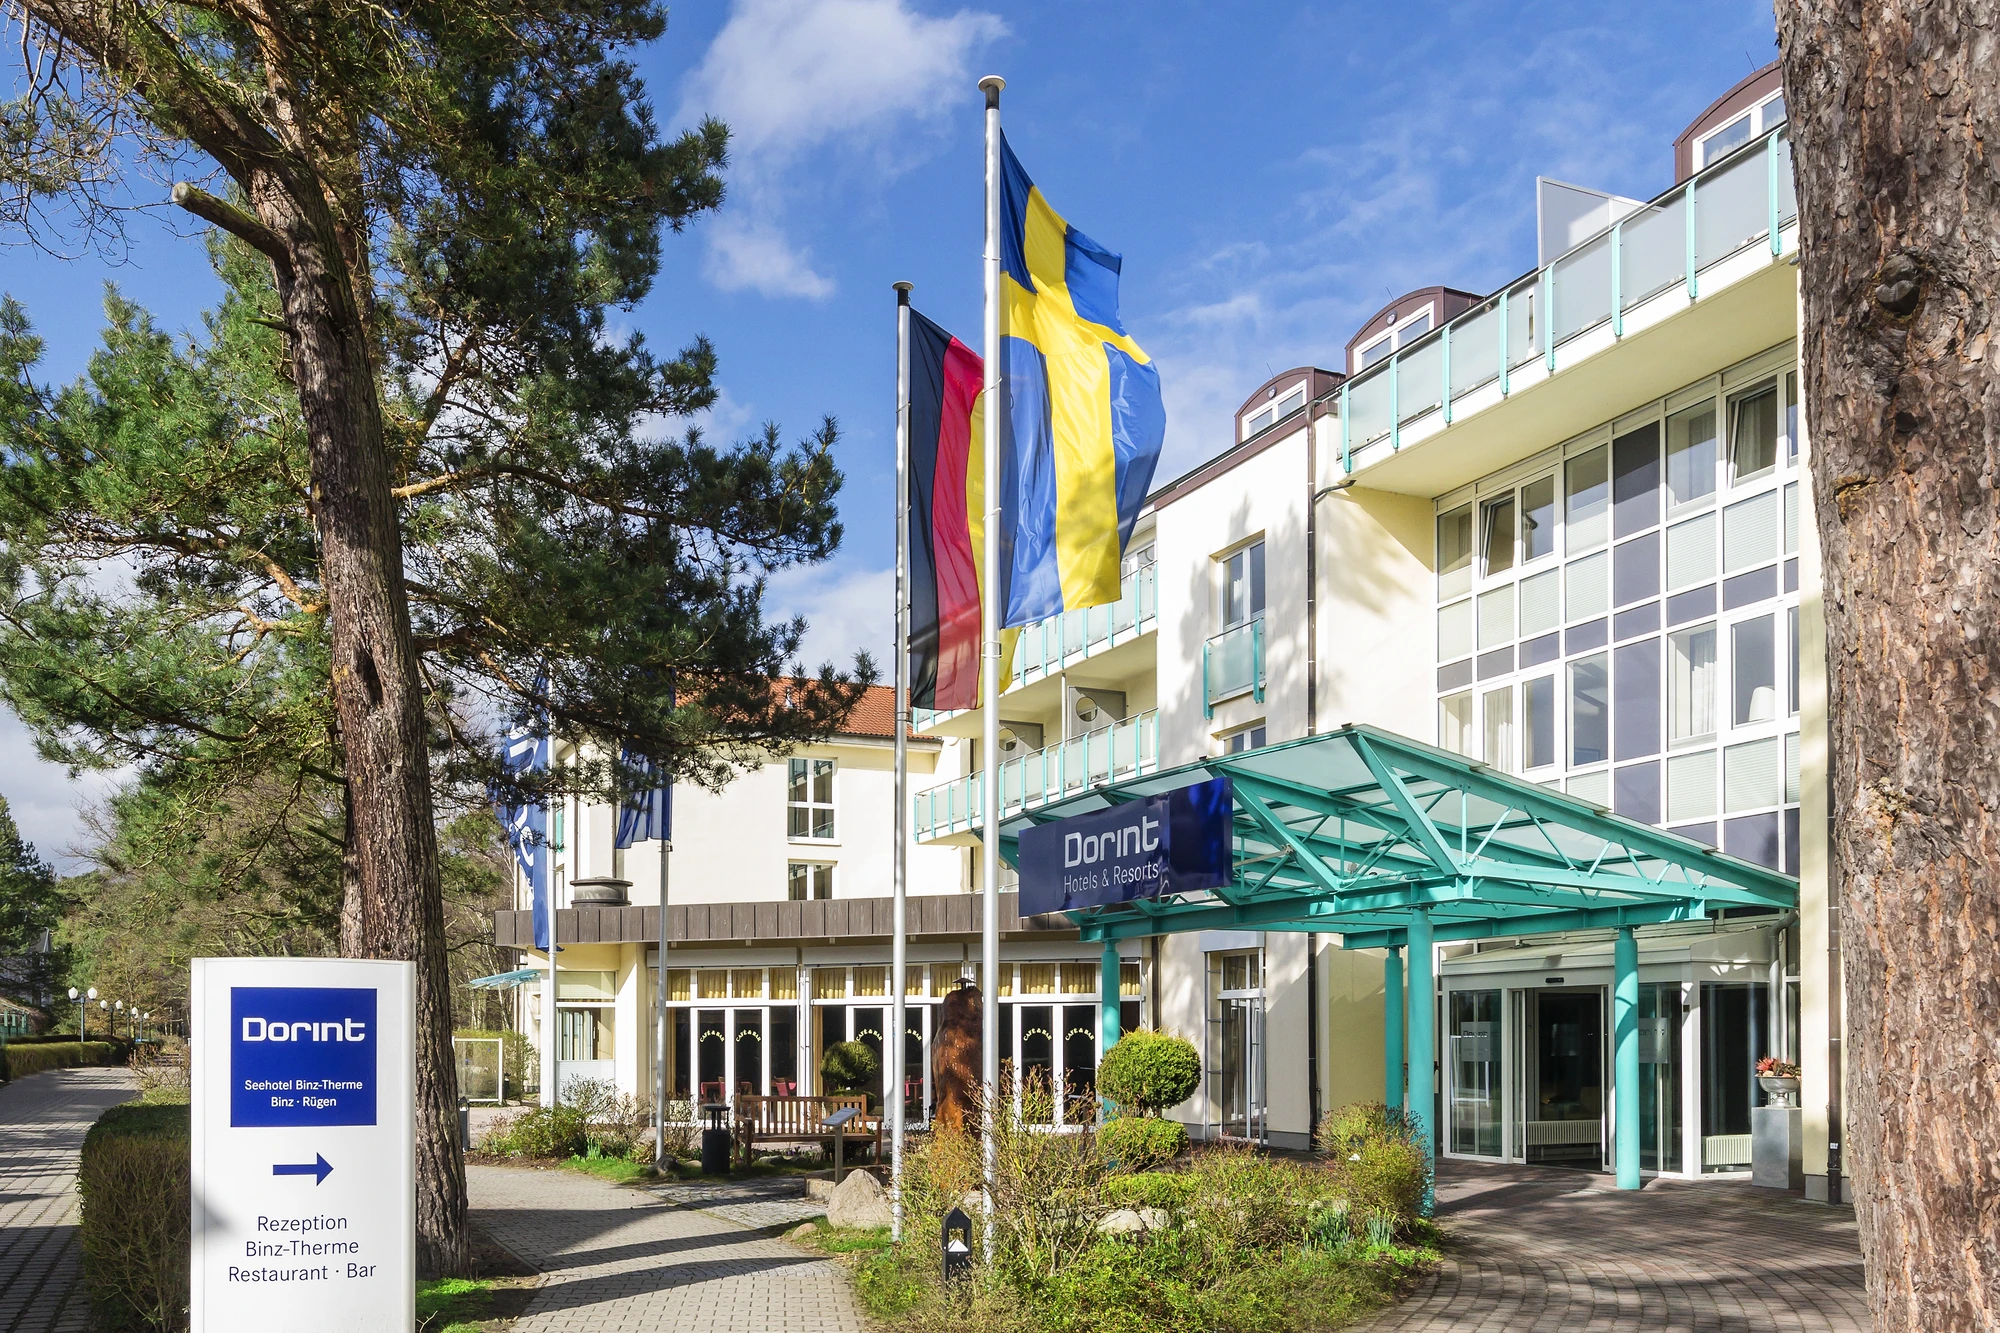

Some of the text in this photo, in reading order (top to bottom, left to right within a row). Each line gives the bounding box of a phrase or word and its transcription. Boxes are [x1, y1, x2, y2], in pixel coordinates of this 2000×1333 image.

[1064, 815, 1158, 868] Dorint
[1064, 861, 1159, 894] Hotels & Resorts
[242, 1017, 366, 1042] Dorint
[244, 1079, 363, 1091] Seehotel Binz-Therme
[271, 1096, 294, 1108] Binz
[302, 1096, 337, 1110] Rügen
[257, 1214, 348, 1235] Rezeption
[246, 1240, 359, 1257] Binz-Therme
[229, 1265, 329, 1283] Restaurant
[347, 1262, 377, 1280] Bar
